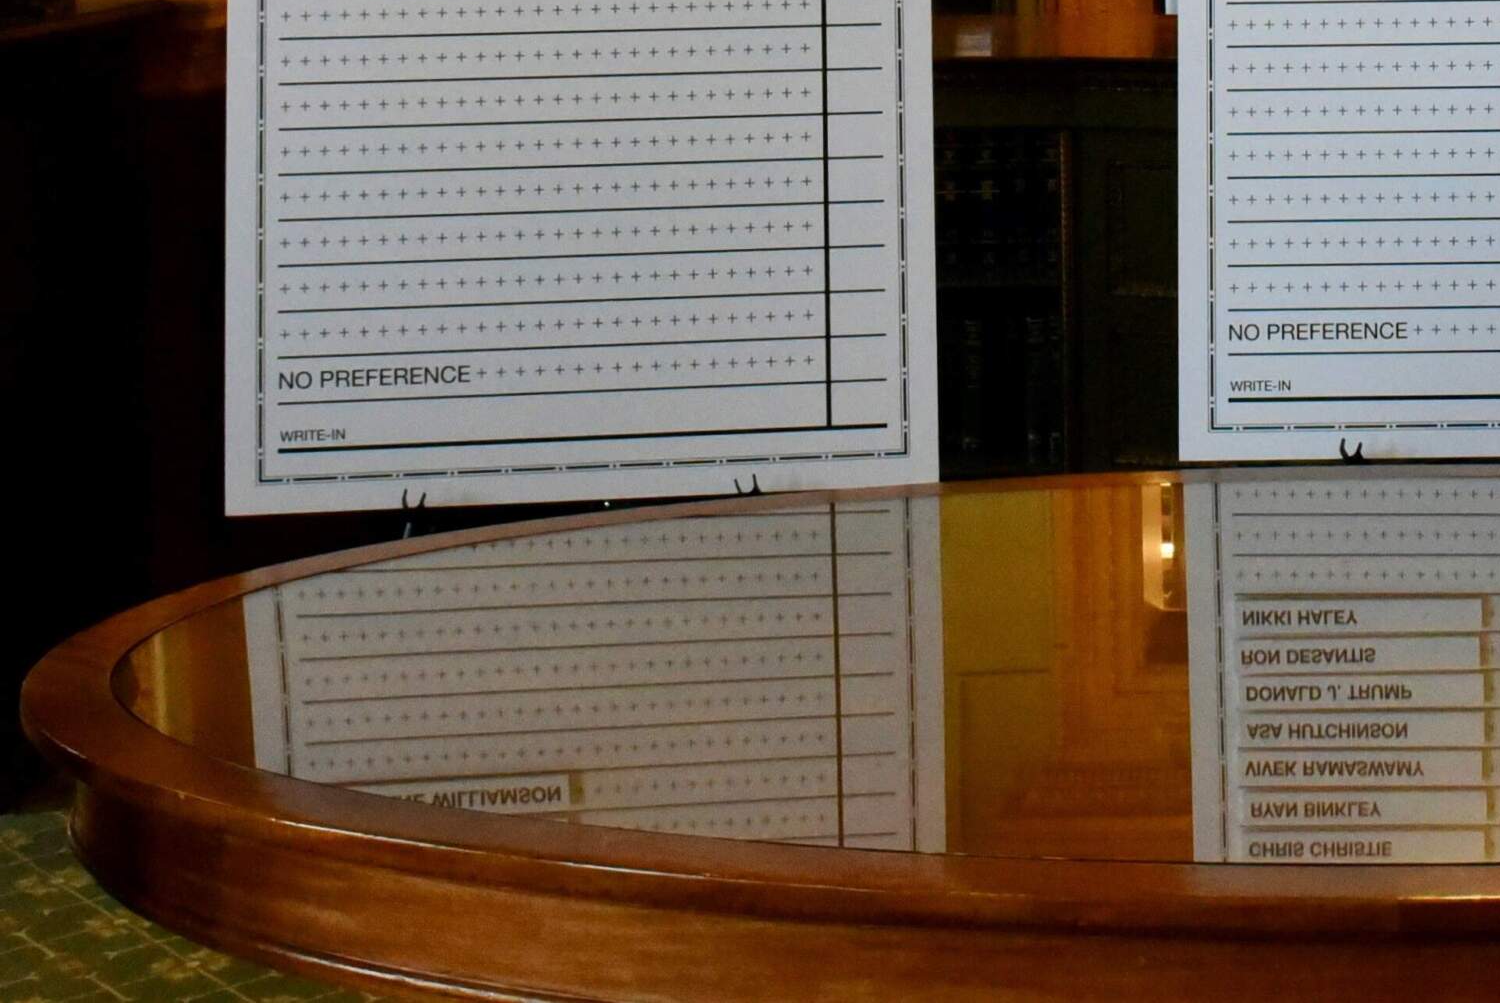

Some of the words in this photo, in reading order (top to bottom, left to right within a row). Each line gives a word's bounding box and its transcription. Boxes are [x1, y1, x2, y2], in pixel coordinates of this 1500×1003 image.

[1228, 323, 1260, 341] NO
[1267, 322, 1408, 341] PREFERENCE
[278, 371, 313, 390] NO
[320, 365, 470, 388] PREFERENCE
[1230, 380, 1291, 392] WRITE-IN
[280, 428, 346, 442] WRITE-IN
